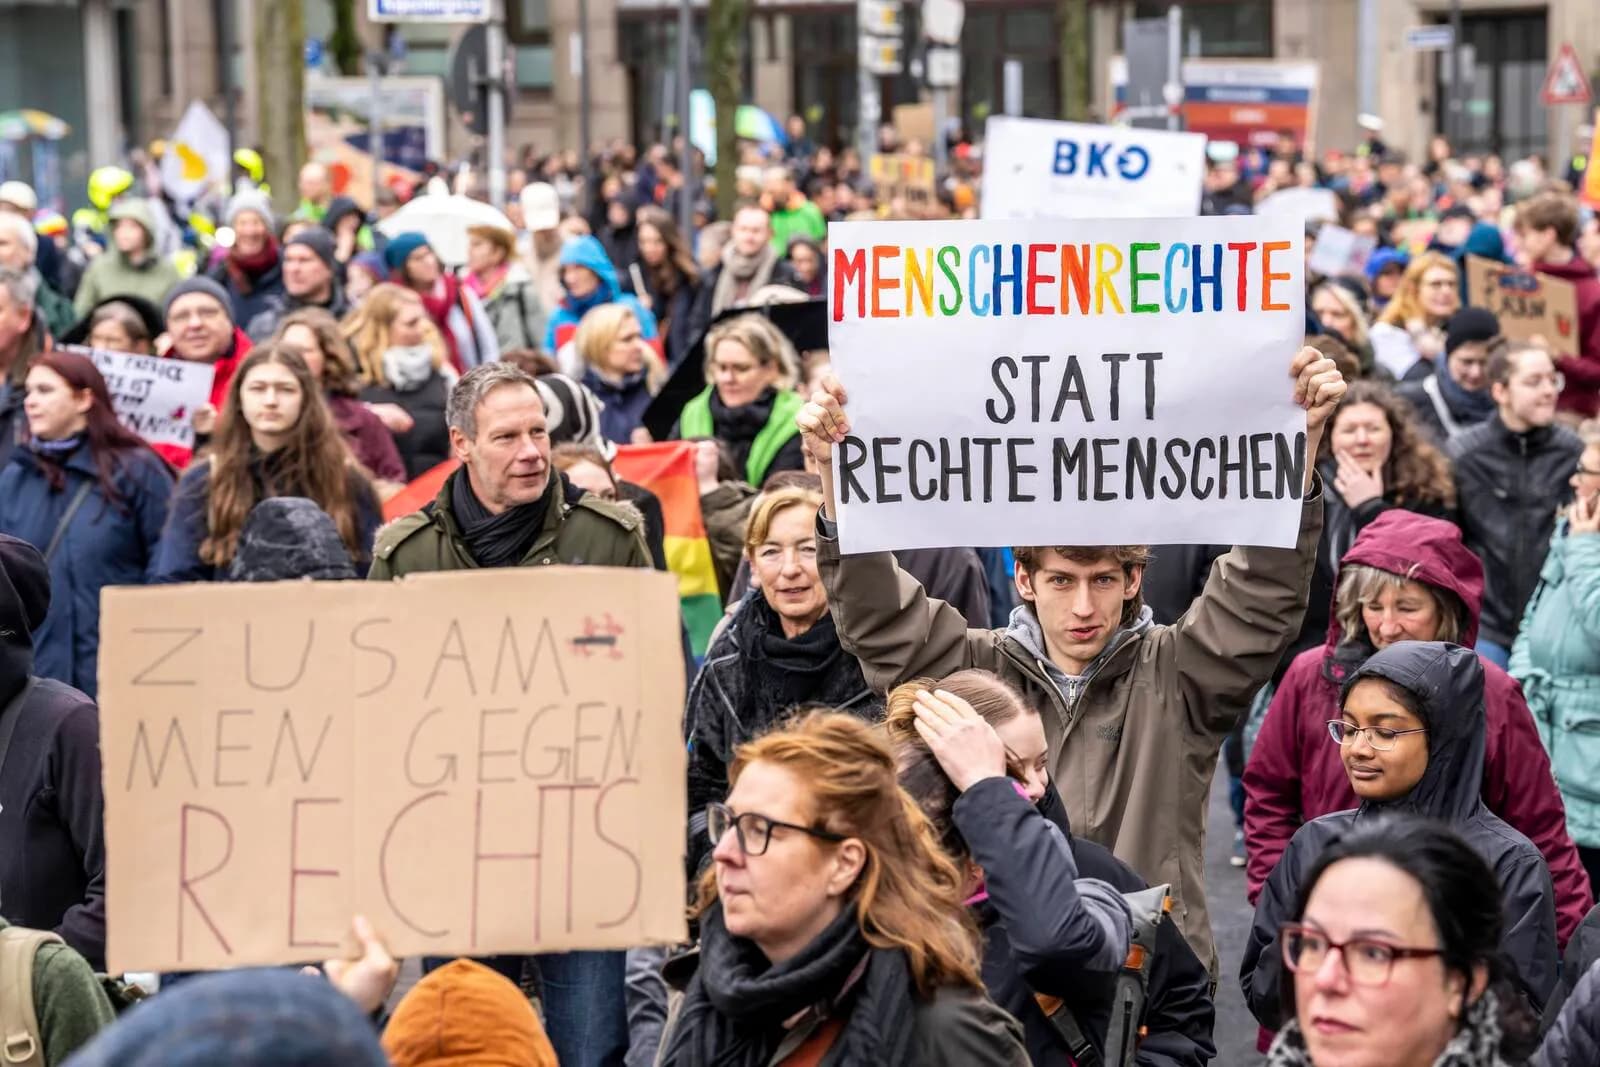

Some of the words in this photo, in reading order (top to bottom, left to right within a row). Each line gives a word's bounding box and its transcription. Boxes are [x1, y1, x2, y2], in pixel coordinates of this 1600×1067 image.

[833, 241, 1291, 322] MENSCHENRECHTE
[985, 352, 1163, 425] STATT
[838, 435, 1038, 505] RECHTE
[1052, 432, 1307, 503] MENSCHEN
[126, 710, 333, 792] MEN
[403, 702, 642, 788] GEGEN
[177, 777, 642, 962] RECHTS
